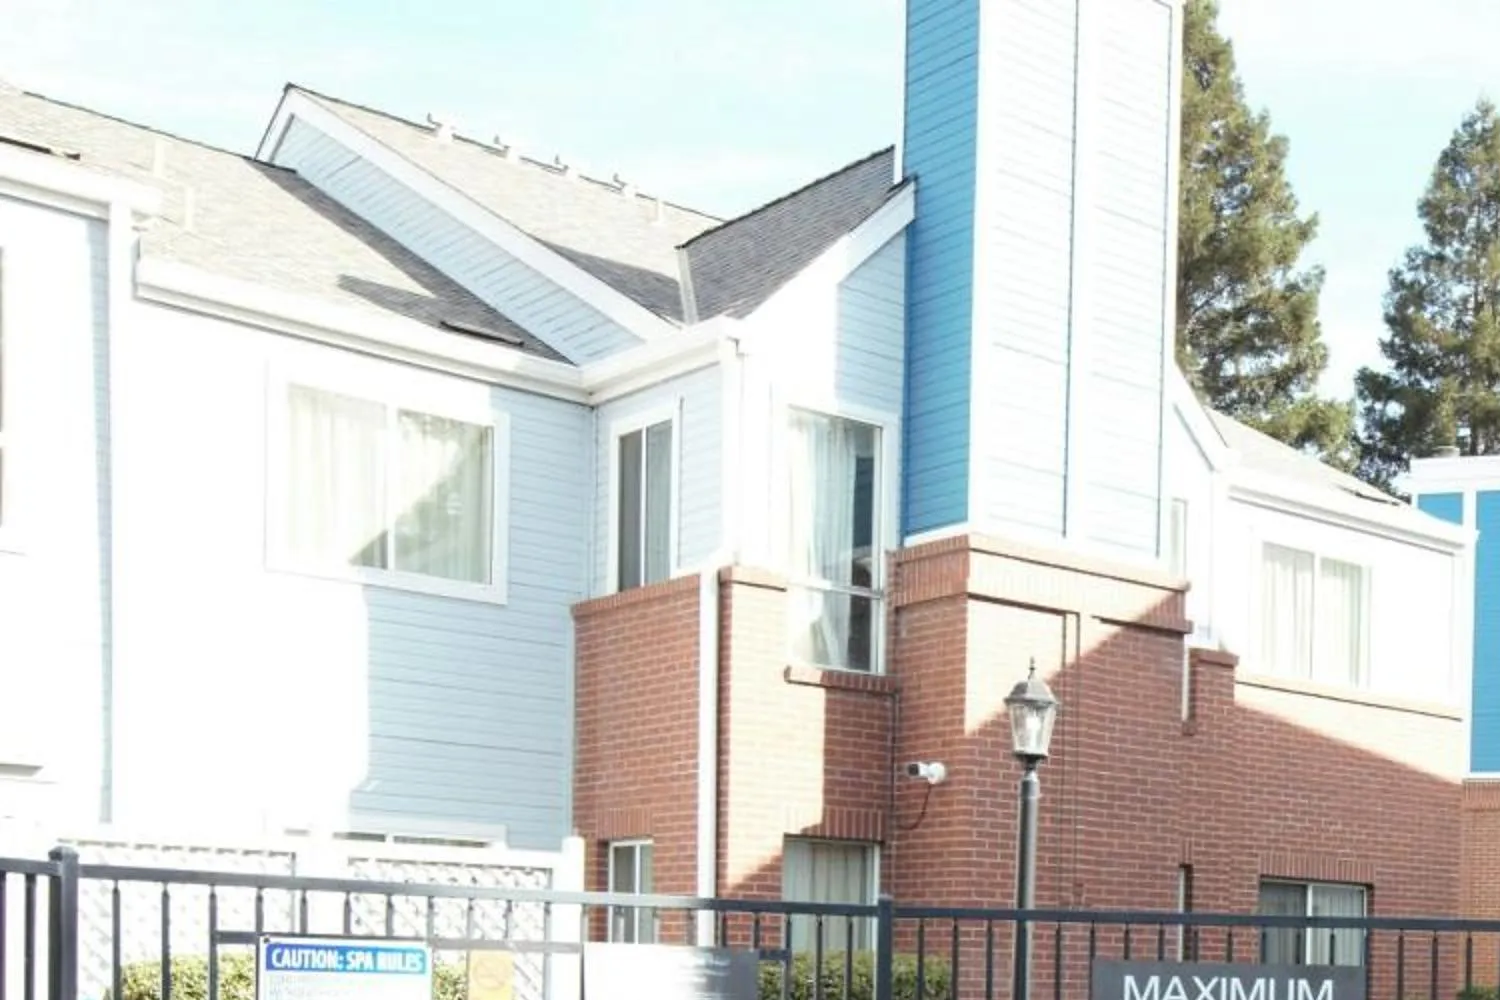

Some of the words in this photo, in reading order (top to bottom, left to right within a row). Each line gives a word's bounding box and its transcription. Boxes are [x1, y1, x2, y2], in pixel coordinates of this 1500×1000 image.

[271, 947, 344, 969] CAUTION:
[346, 949, 375, 971] SPA
[377, 951, 424, 973] RULES
